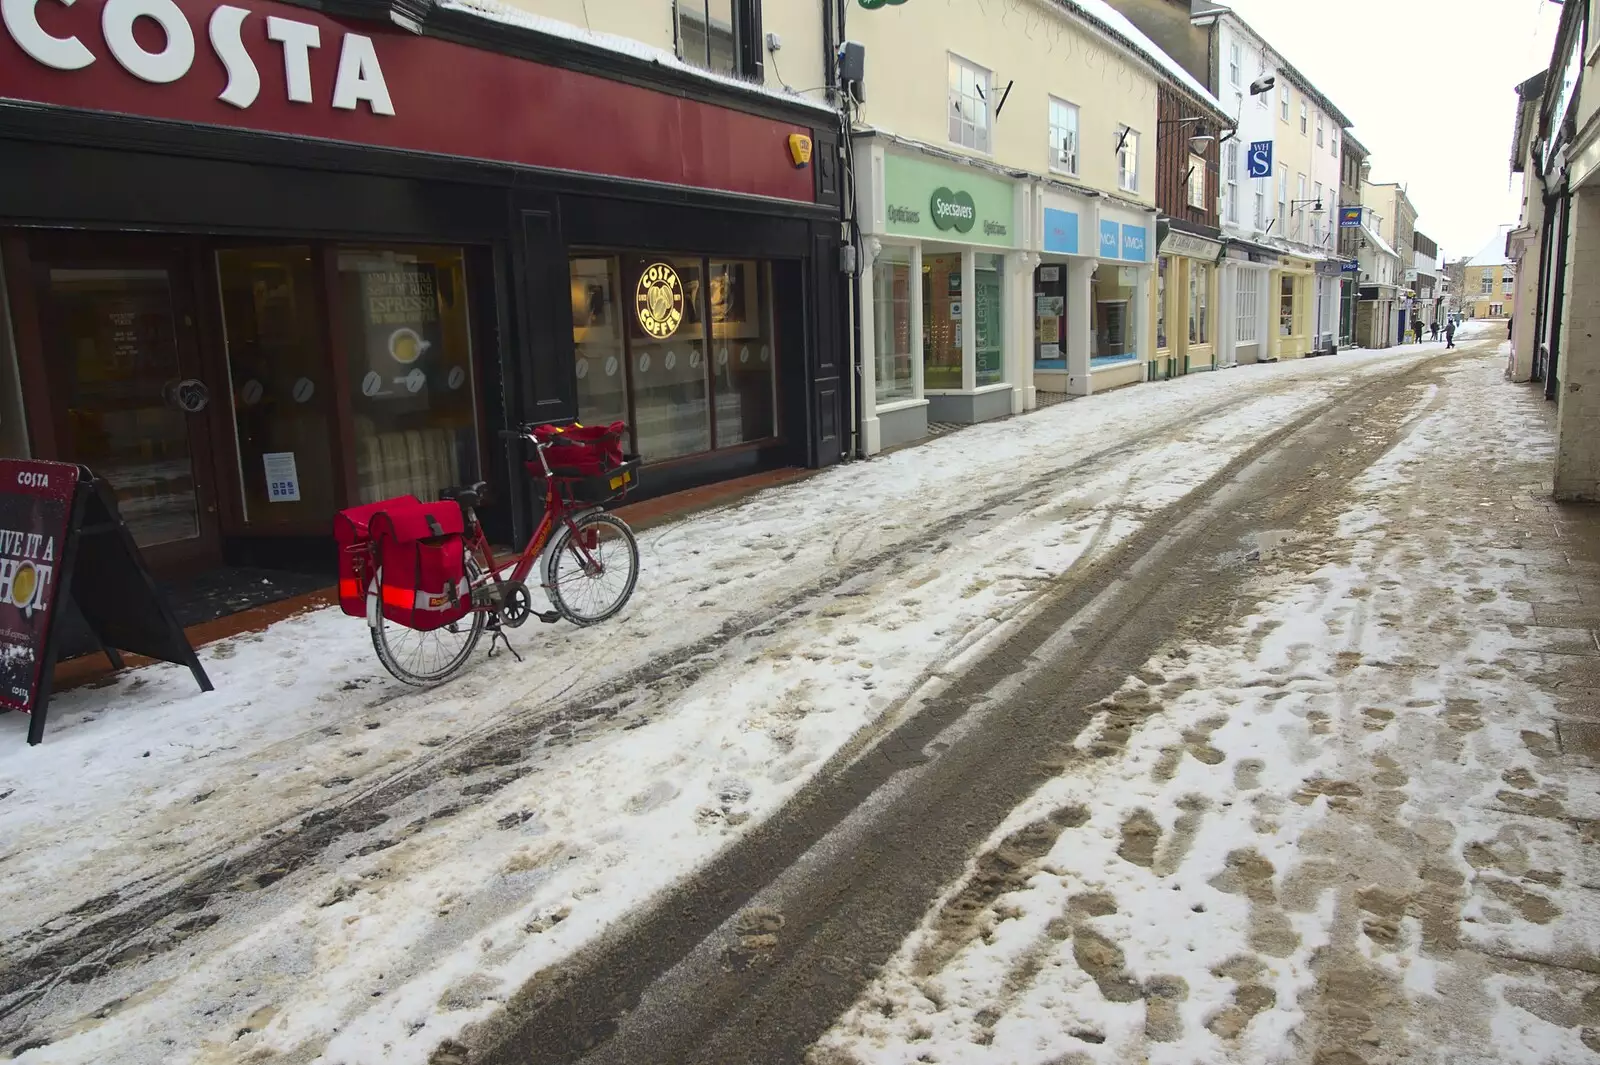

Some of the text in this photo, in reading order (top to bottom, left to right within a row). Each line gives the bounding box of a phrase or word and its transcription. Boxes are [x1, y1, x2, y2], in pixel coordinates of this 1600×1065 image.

[1, 0, 396, 116] COSTA
[936, 198, 972, 218] Specsavers
[643, 266, 676, 289] COSTA
[641, 309, 681, 335] COFFEE
[18, 472, 48, 488] COSTA
[0, 530, 53, 561] IVE IT A
